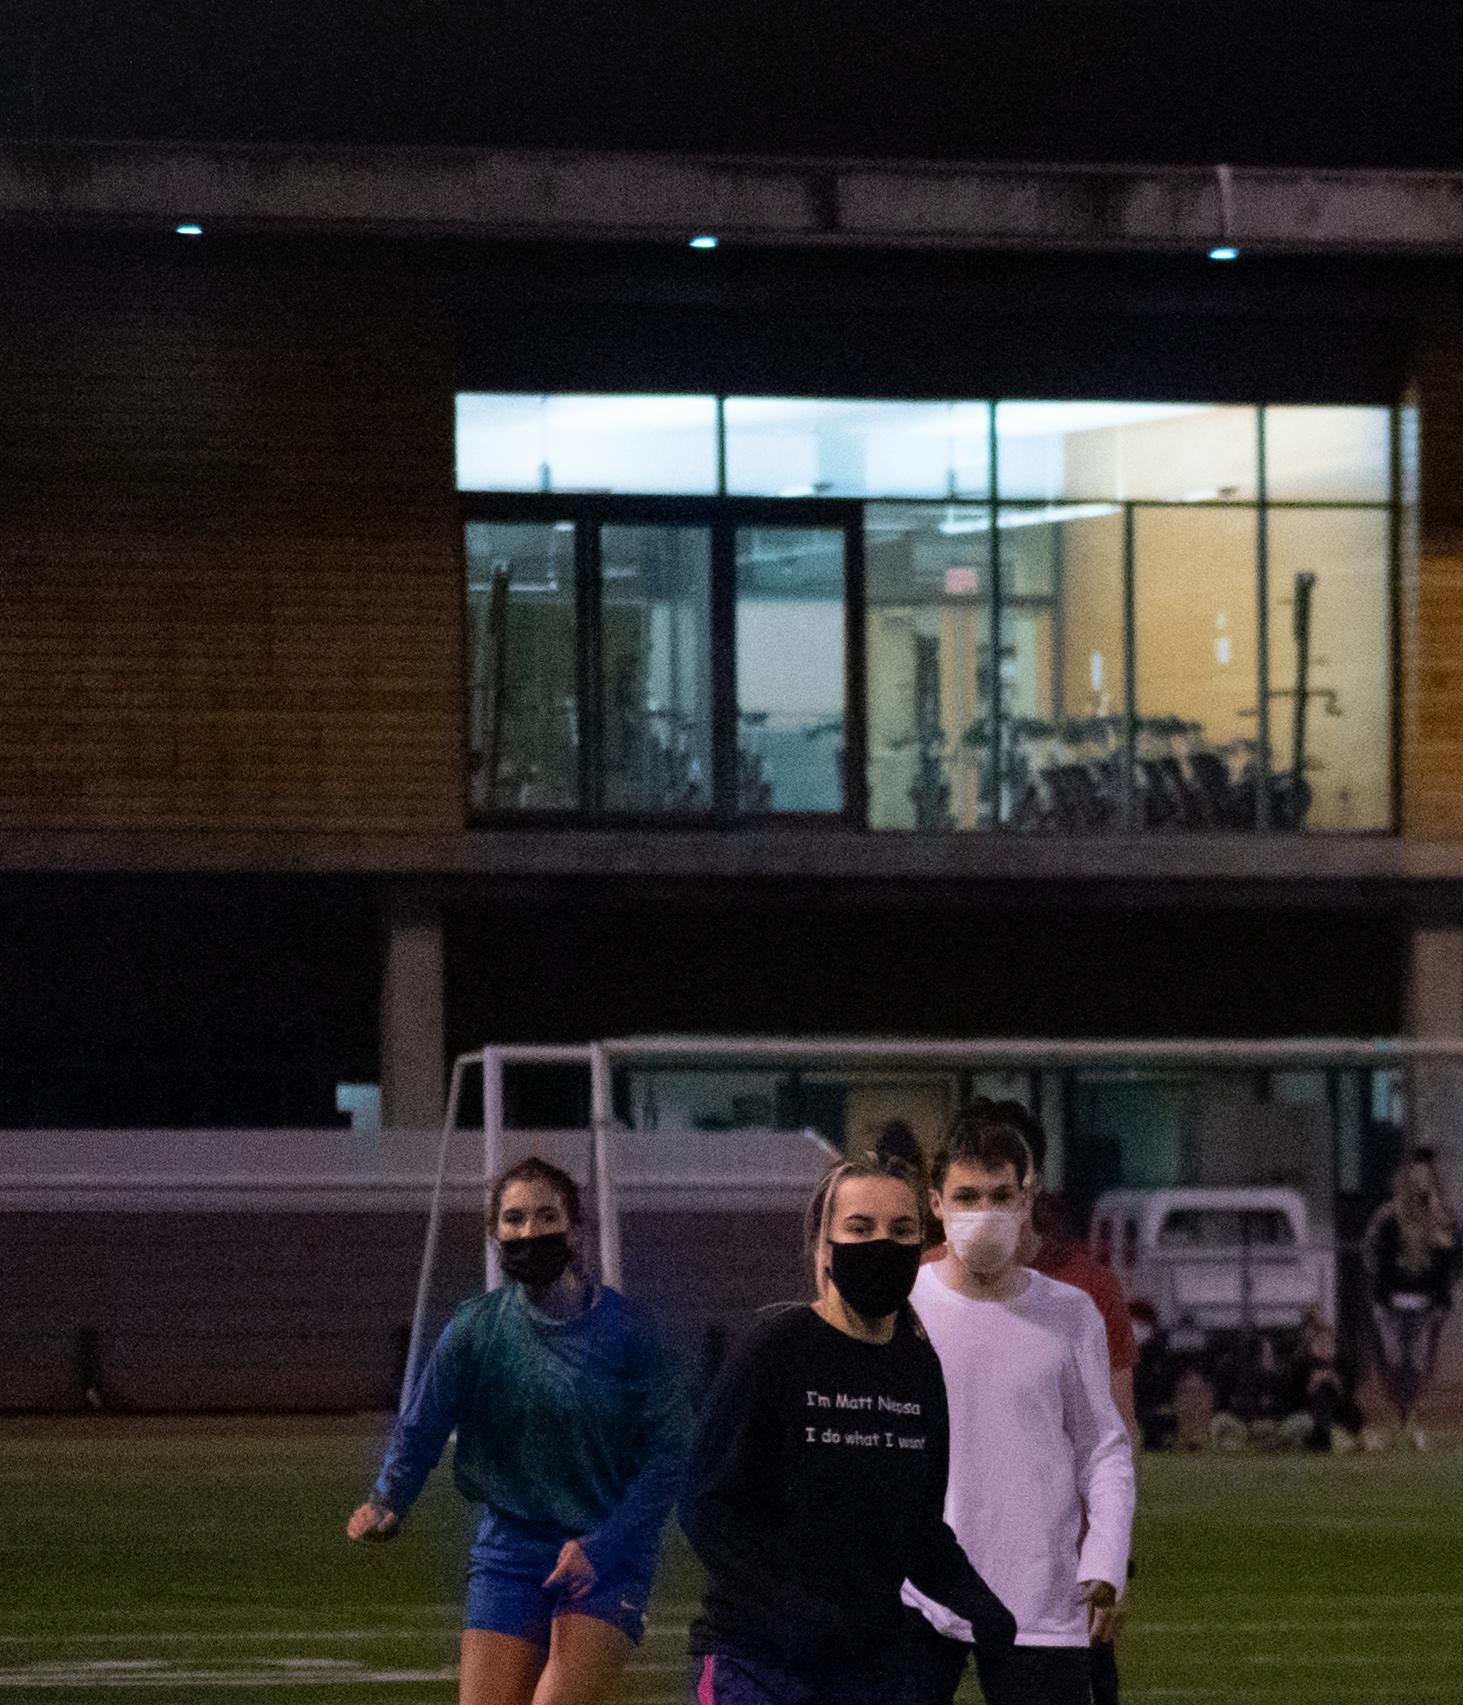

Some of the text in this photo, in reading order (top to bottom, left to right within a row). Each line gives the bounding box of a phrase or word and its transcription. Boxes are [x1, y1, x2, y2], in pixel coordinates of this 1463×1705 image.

[806, 1391, 831, 1408] I'm
[836, 1393, 873, 1410] Matt
[805, 1427, 816, 1442] I
[821, 1428, 841, 1443] do
[845, 1430, 880, 1447] what
[884, 1432, 894, 1447] I
